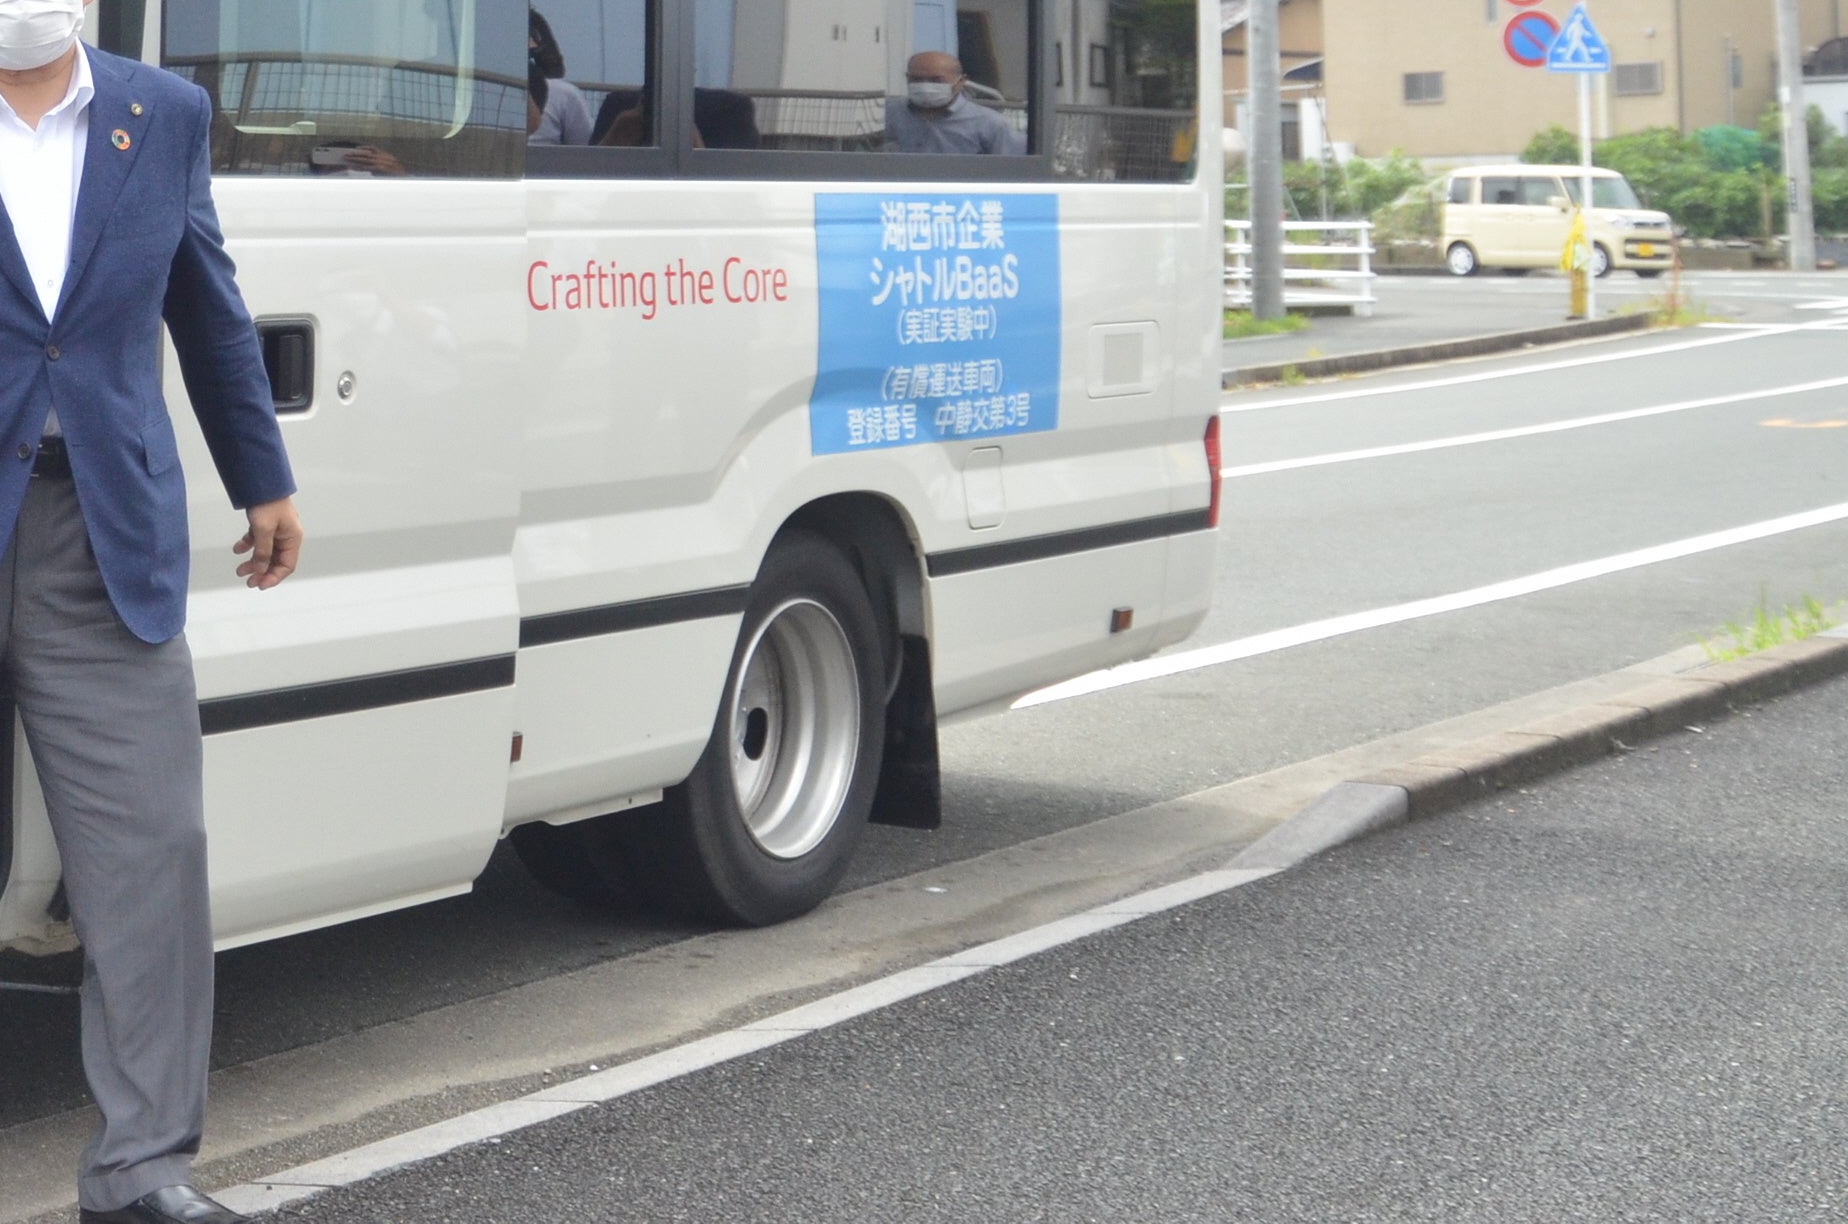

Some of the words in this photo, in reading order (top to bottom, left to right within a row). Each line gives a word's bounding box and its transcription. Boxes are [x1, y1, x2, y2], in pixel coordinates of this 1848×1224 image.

[881, 200, 1004, 251] 湖西市企業
[527, 260, 656, 320] Crafting
[664, 258, 714, 305] the
[723, 256, 787, 303] Core
[869, 254, 1019, 306] シャトルBaaS
[847, 404, 917, 445] 登録番号
[935, 393, 1030, 435] 中静交第3号
